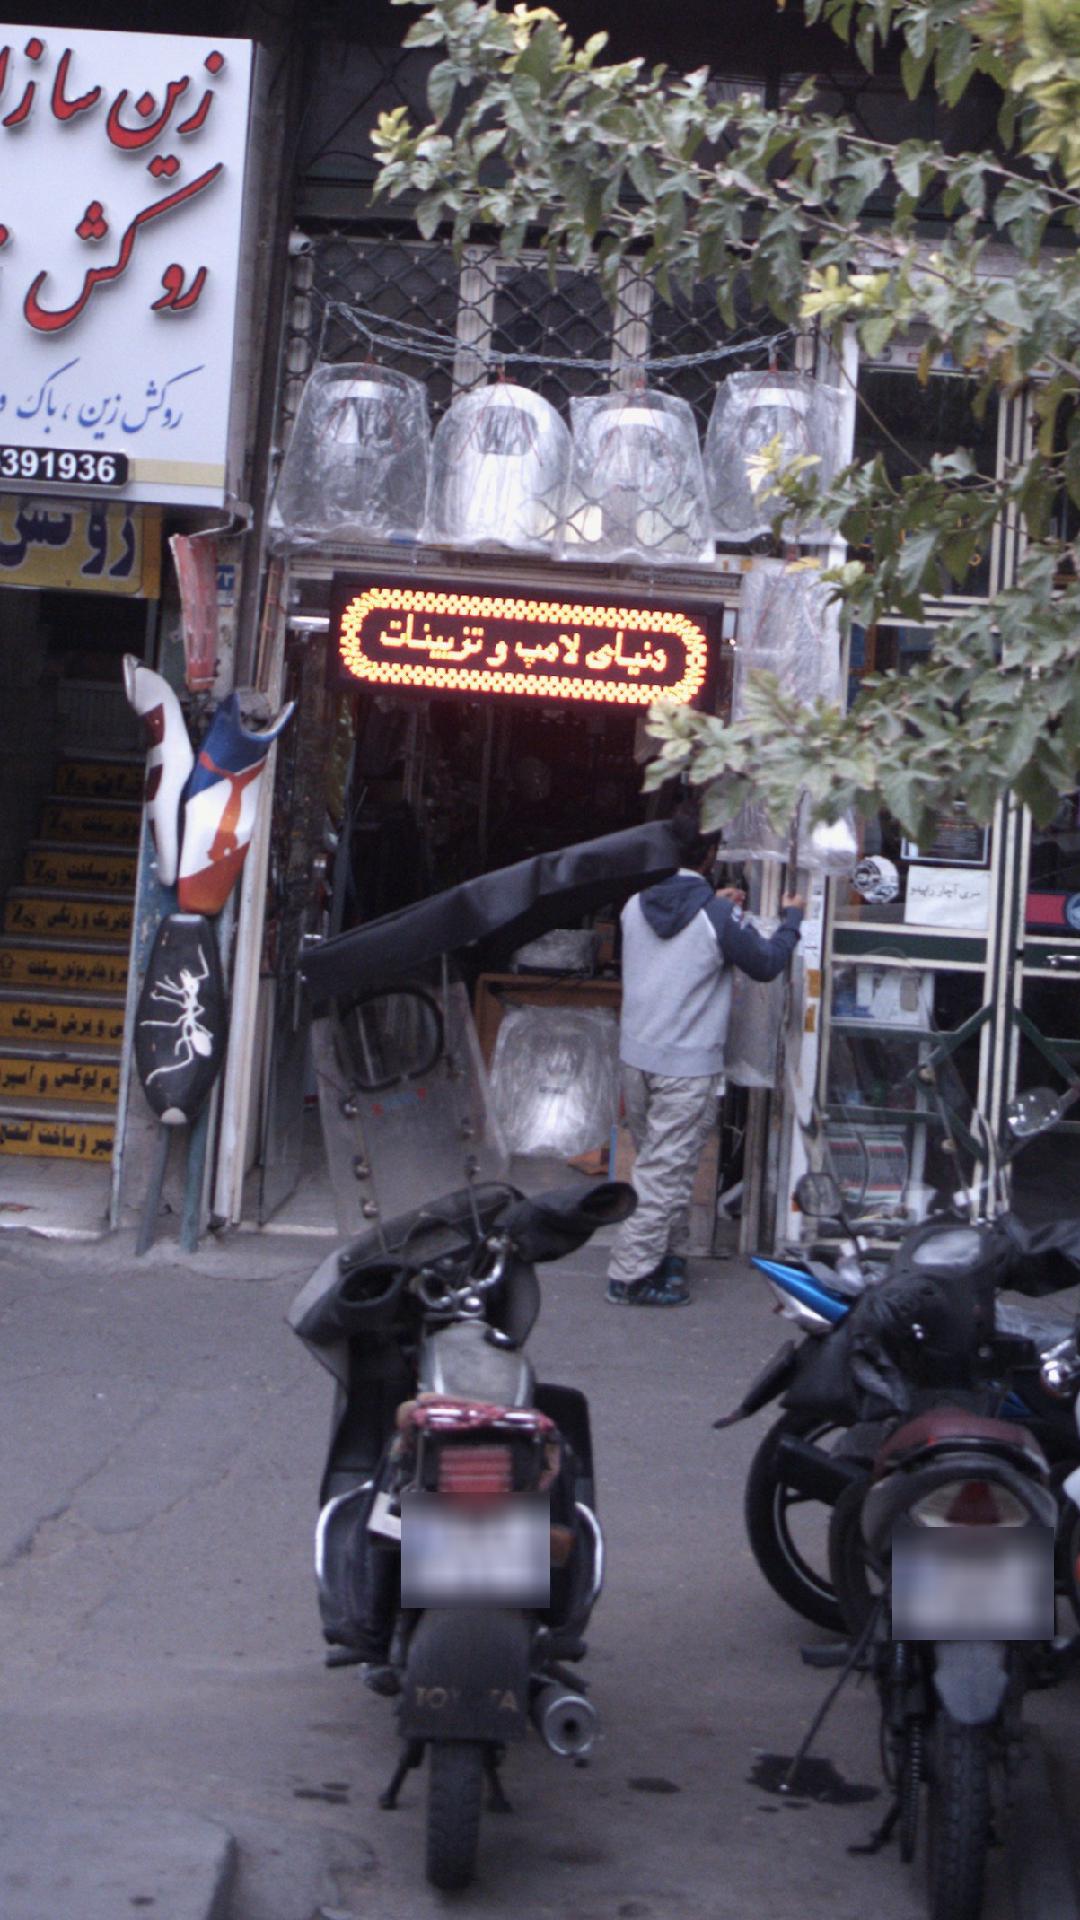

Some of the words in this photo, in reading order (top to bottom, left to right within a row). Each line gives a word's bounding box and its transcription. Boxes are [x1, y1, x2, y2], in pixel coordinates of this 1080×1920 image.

[107, 50, 225, 178] زین
[23, 162, 224, 331] روکش
[121, 364, 205, 434] روکش
[485, 640, 508, 667] و
[514, 632, 581, 669] لامپ
[585, 631, 668, 677] دنیای
